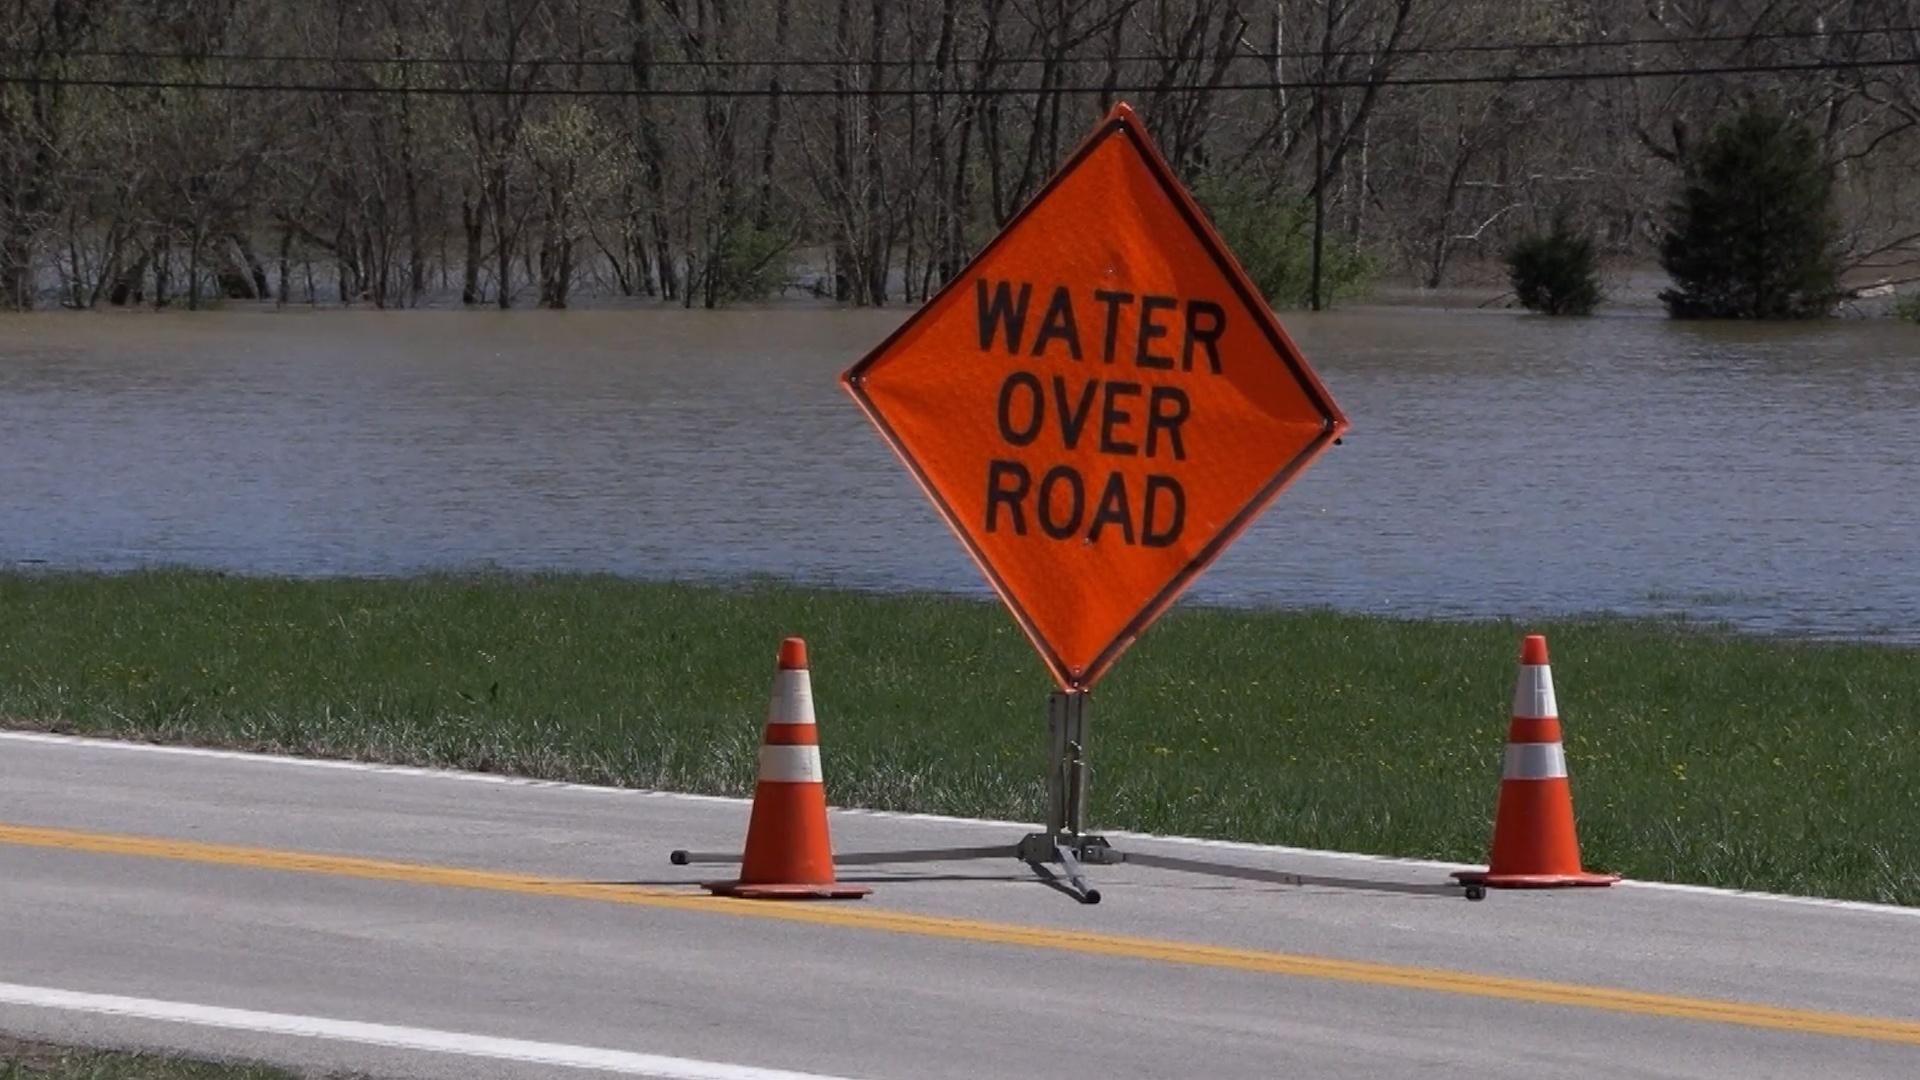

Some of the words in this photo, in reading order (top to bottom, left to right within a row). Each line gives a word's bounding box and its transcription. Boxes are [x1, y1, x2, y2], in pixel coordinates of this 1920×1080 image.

[976, 277, 1225, 374] WATER
[997, 371, 1190, 460] OVER
[986, 460, 1186, 548] ROAD
